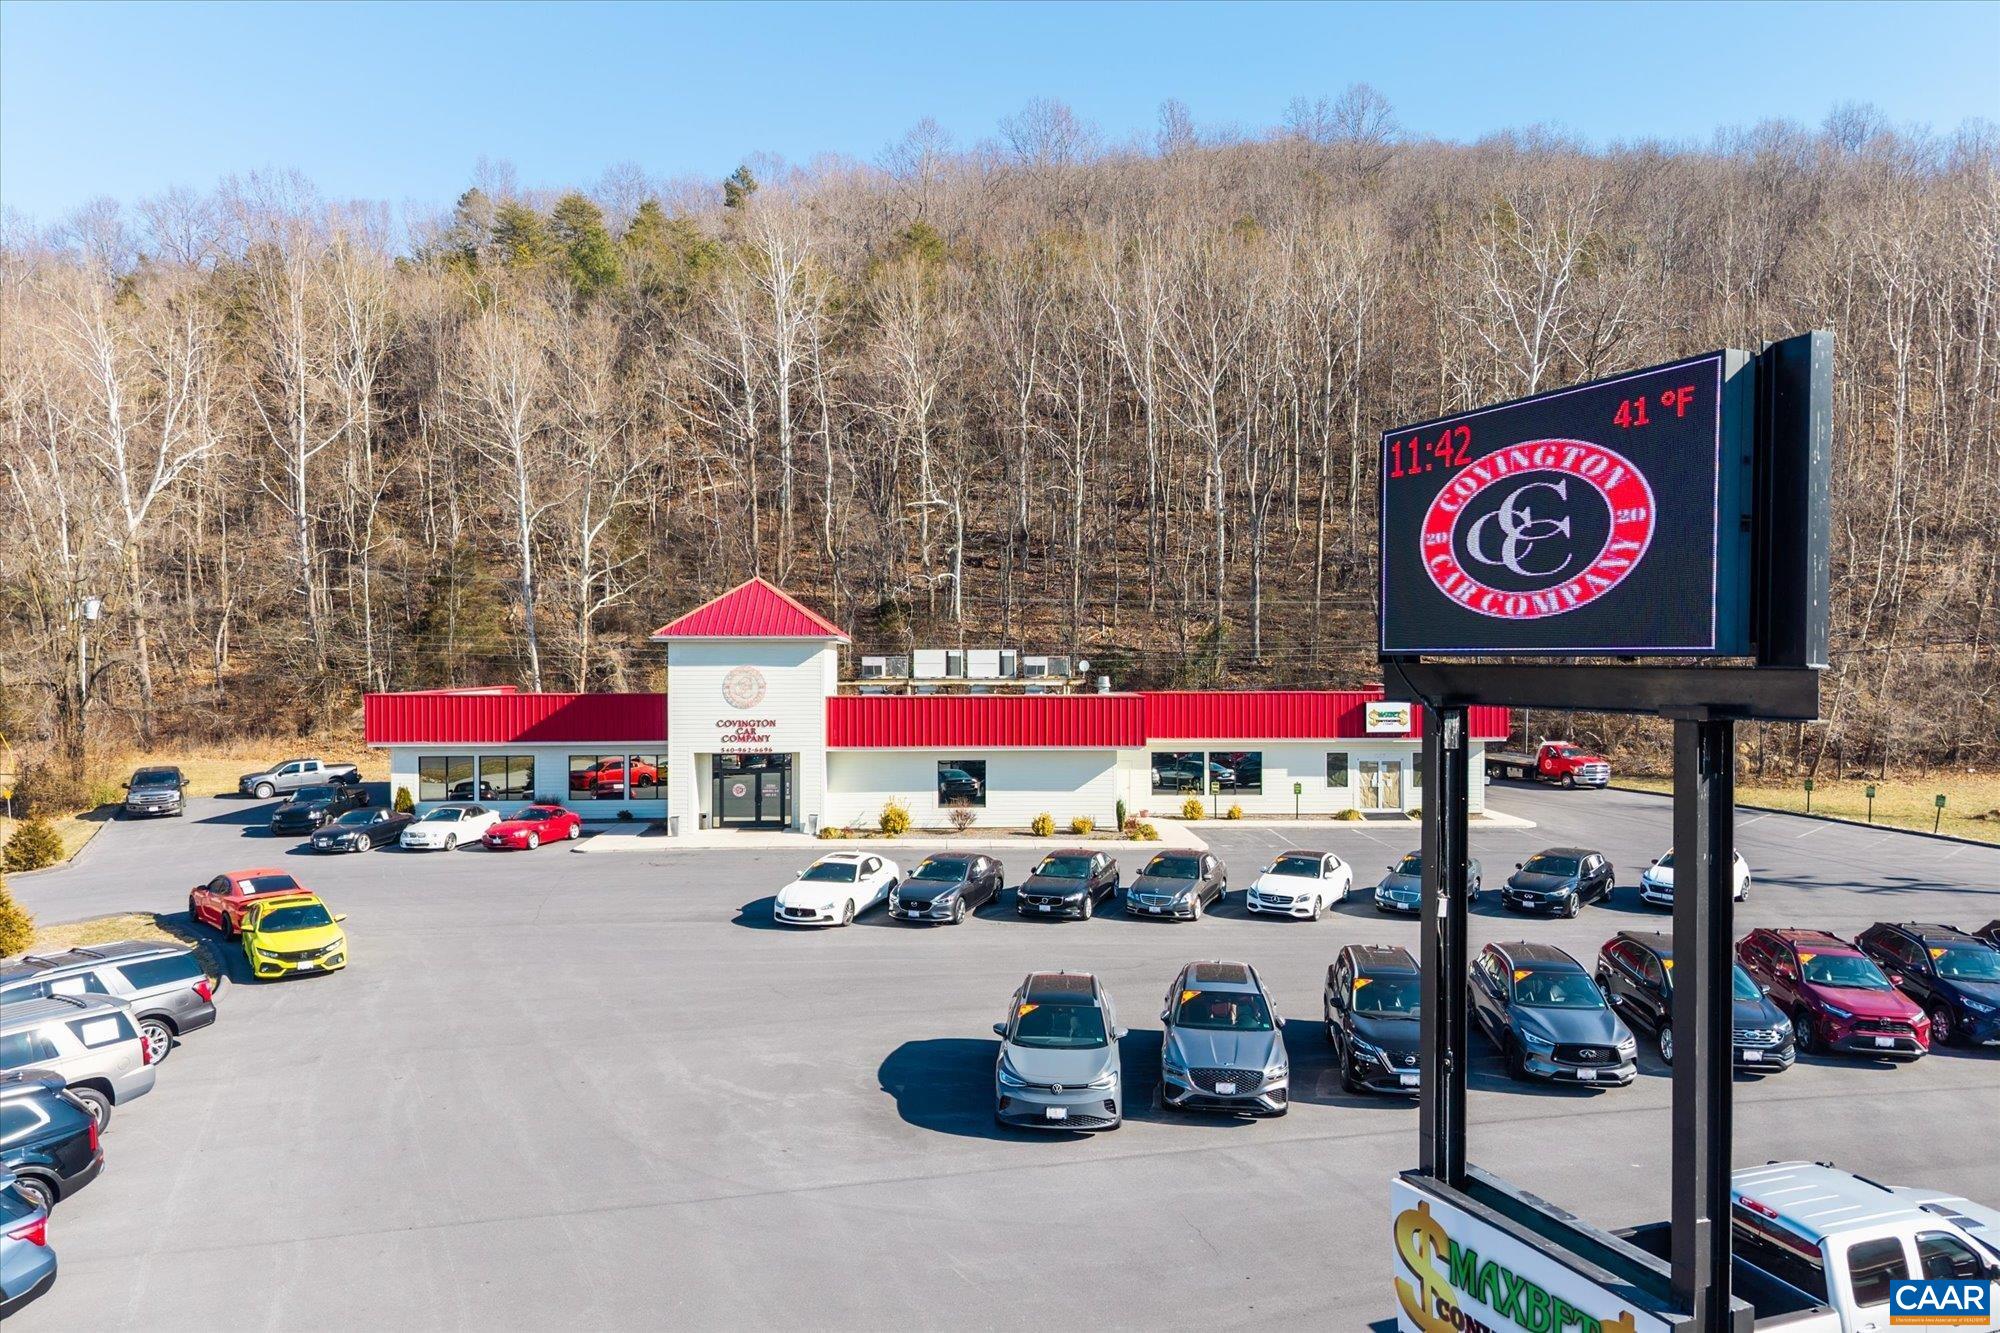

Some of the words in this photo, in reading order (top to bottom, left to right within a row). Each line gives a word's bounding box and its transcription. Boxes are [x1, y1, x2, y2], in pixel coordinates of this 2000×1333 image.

[1613, 396, 1650, 428] 41
[1661, 385, 1695, 418] °F
[1390, 425, 1473, 478] 11:42
[1439, 445, 1631, 513] COVINGTON
[1617, 507, 1646, 523] 20
[1426, 532, 1447, 545] 20
[1430, 553, 1479, 600] CAR
[1480, 540, 1642, 615] COMPANY
[715, 719, 777, 728] COVINGTON
[735, 727, 757, 735] CAR
[721, 734, 771, 743] COMPANY
